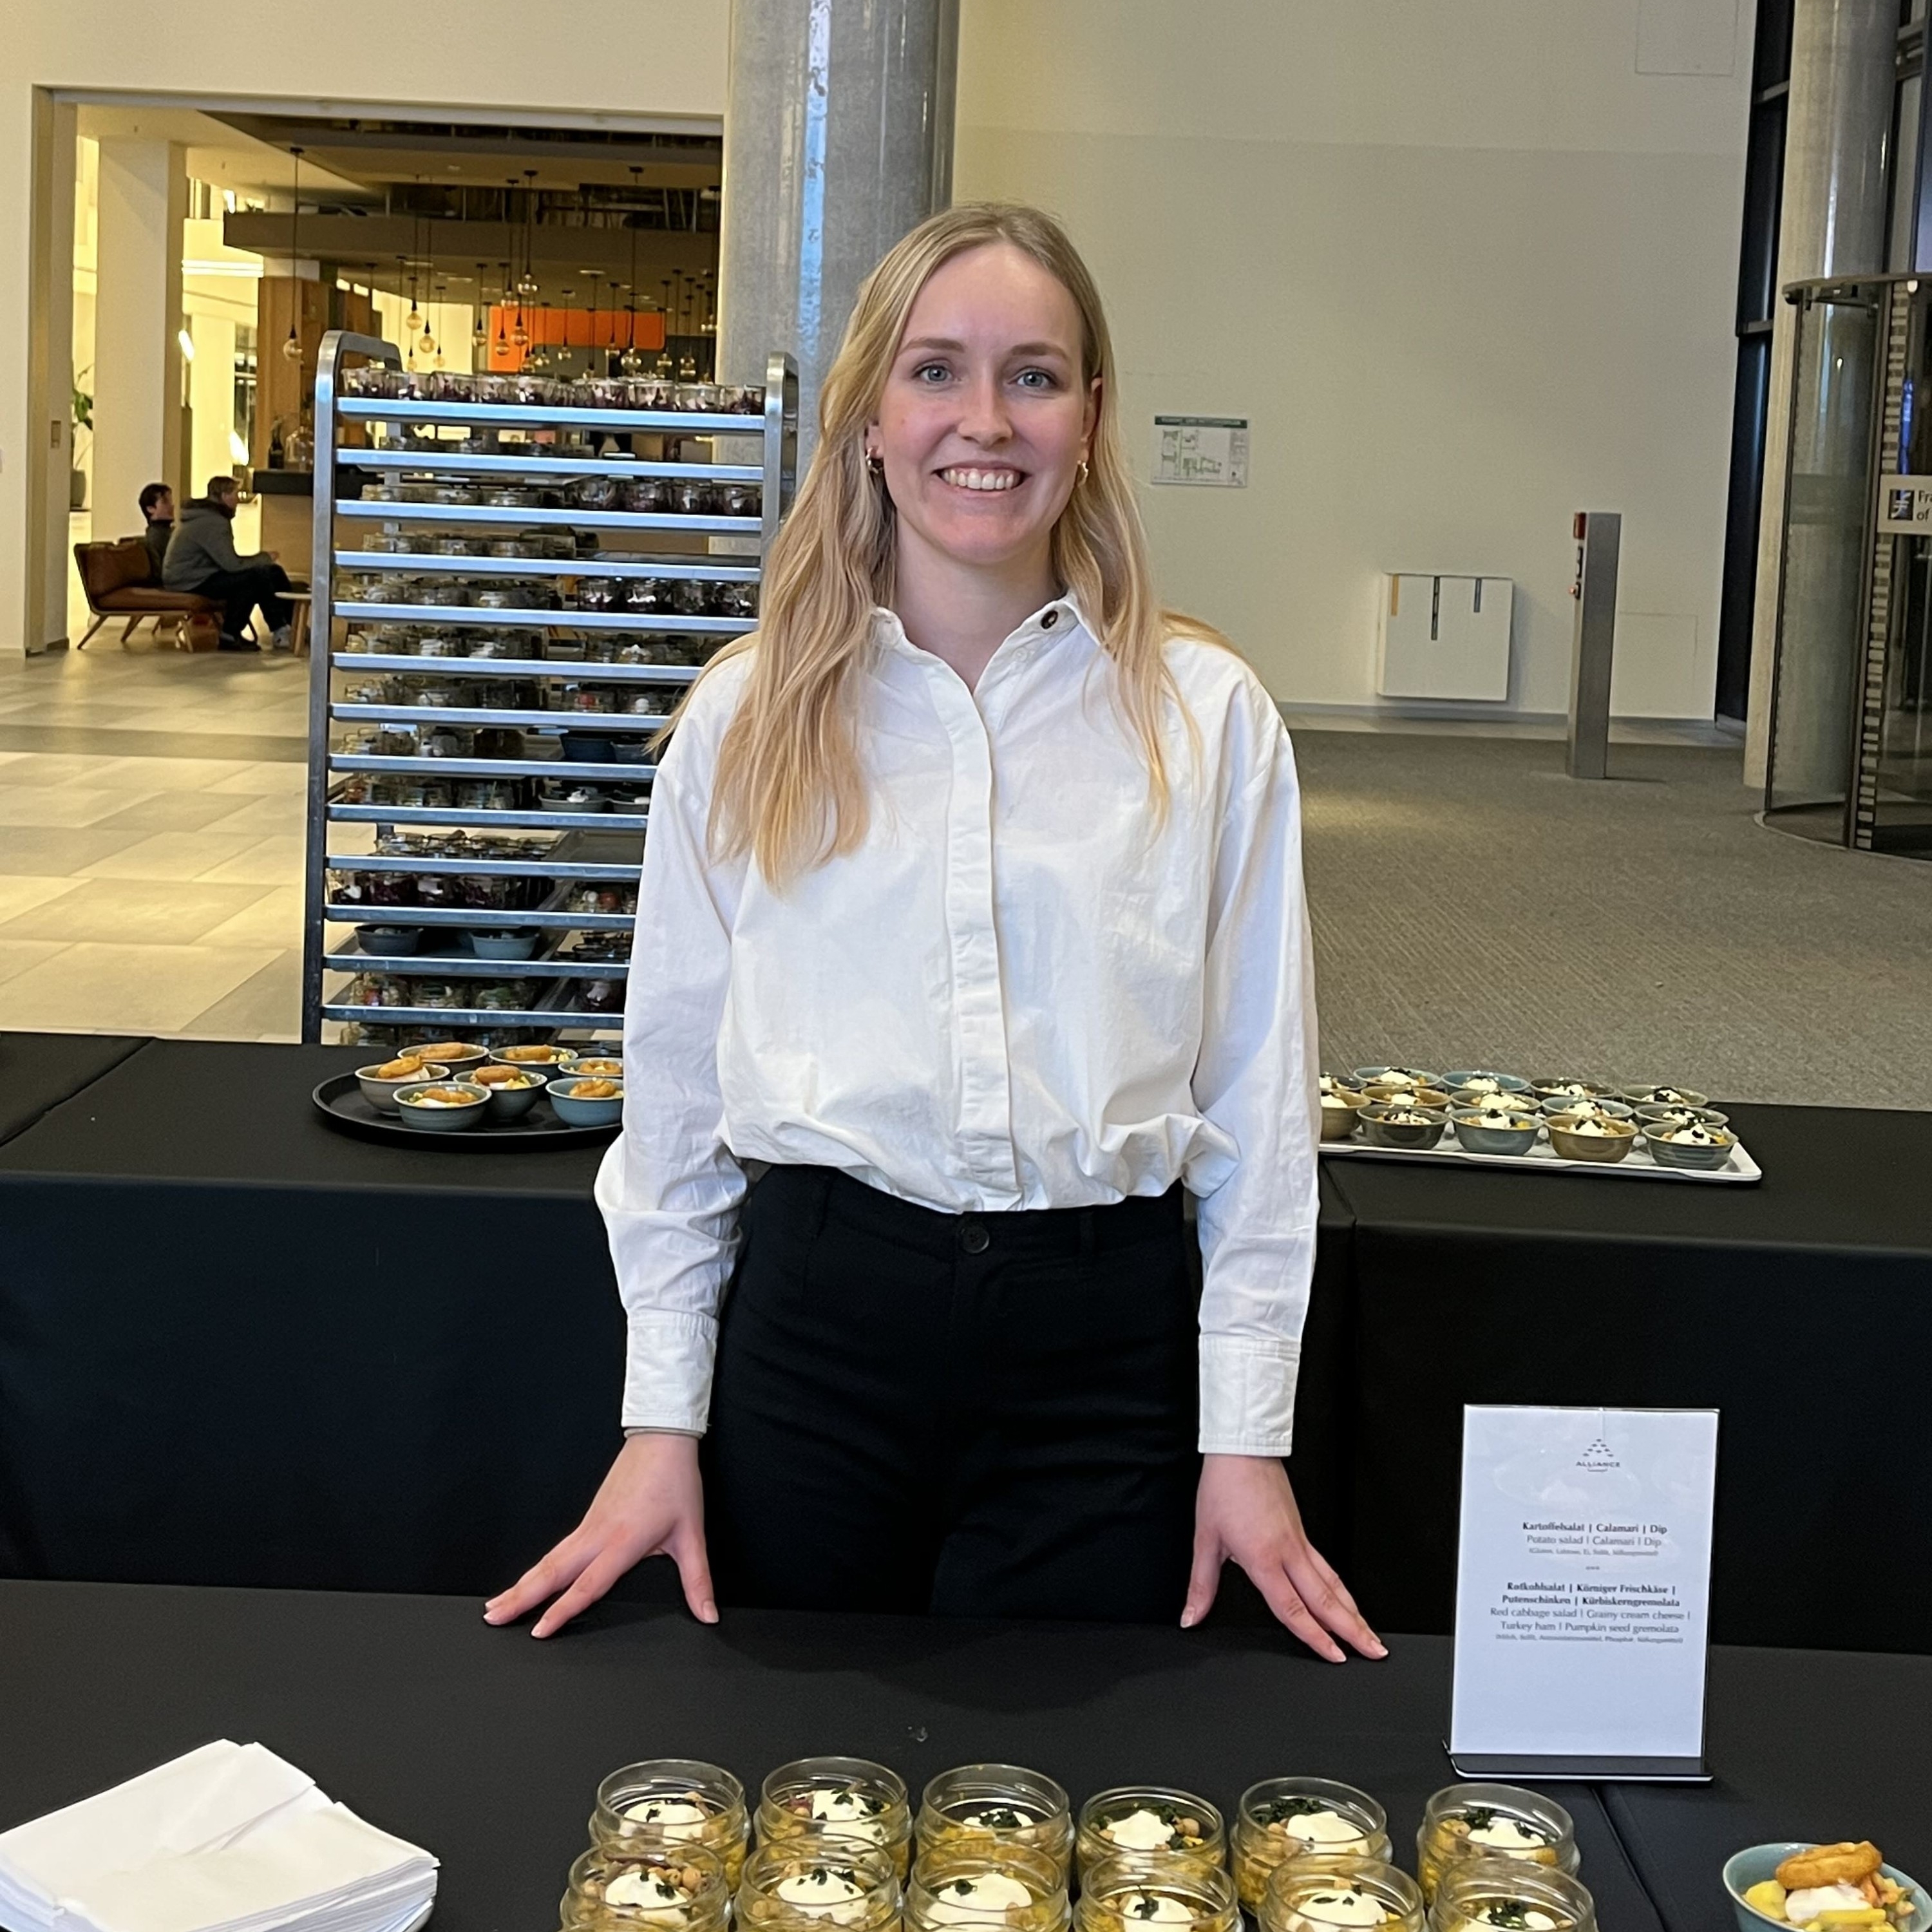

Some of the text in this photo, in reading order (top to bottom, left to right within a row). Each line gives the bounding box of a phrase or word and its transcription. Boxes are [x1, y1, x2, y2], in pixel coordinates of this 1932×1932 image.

[1917, 508, 1930, 522] of
[1523, 1522, 1585, 1531] Kartoffelsalat
[1596, 1523, 1638, 1533] Calamari
[1650, 1524, 1667, 1535] Dip
[1527, 1535, 1557, 1544] Potato
[1558, 1535, 1583, 1544] salad
[1592, 1536, 1634, 1546] Calamari
[1644, 1537, 1662, 1548] Dip
[1508, 1582, 1566, 1591] Rotkohlsalat
[1577, 1584, 1617, 1594] Körniger
[1620, 1584, 1668, 1594] Frischkäse
[1502, 1595, 1571, 1604] Putenschinken
[1490, 1607, 1508, 1616] Red
[1511, 1607, 1550, 1618] cabbage
[1553, 1609, 1577, 1617] salad
[1586, 1609, 1617, 1621] Grainy
[1652, 1610, 1685, 1620] cheese
[1501, 1621, 1533, 1632] Turkey
[1535, 1622, 1556, 1631] ham
[1565, 1622, 1607, 1634] Pumpkin
[1609, 1623, 1630, 1632] seed
[1633, 1624, 1680, 1634] gremolata
